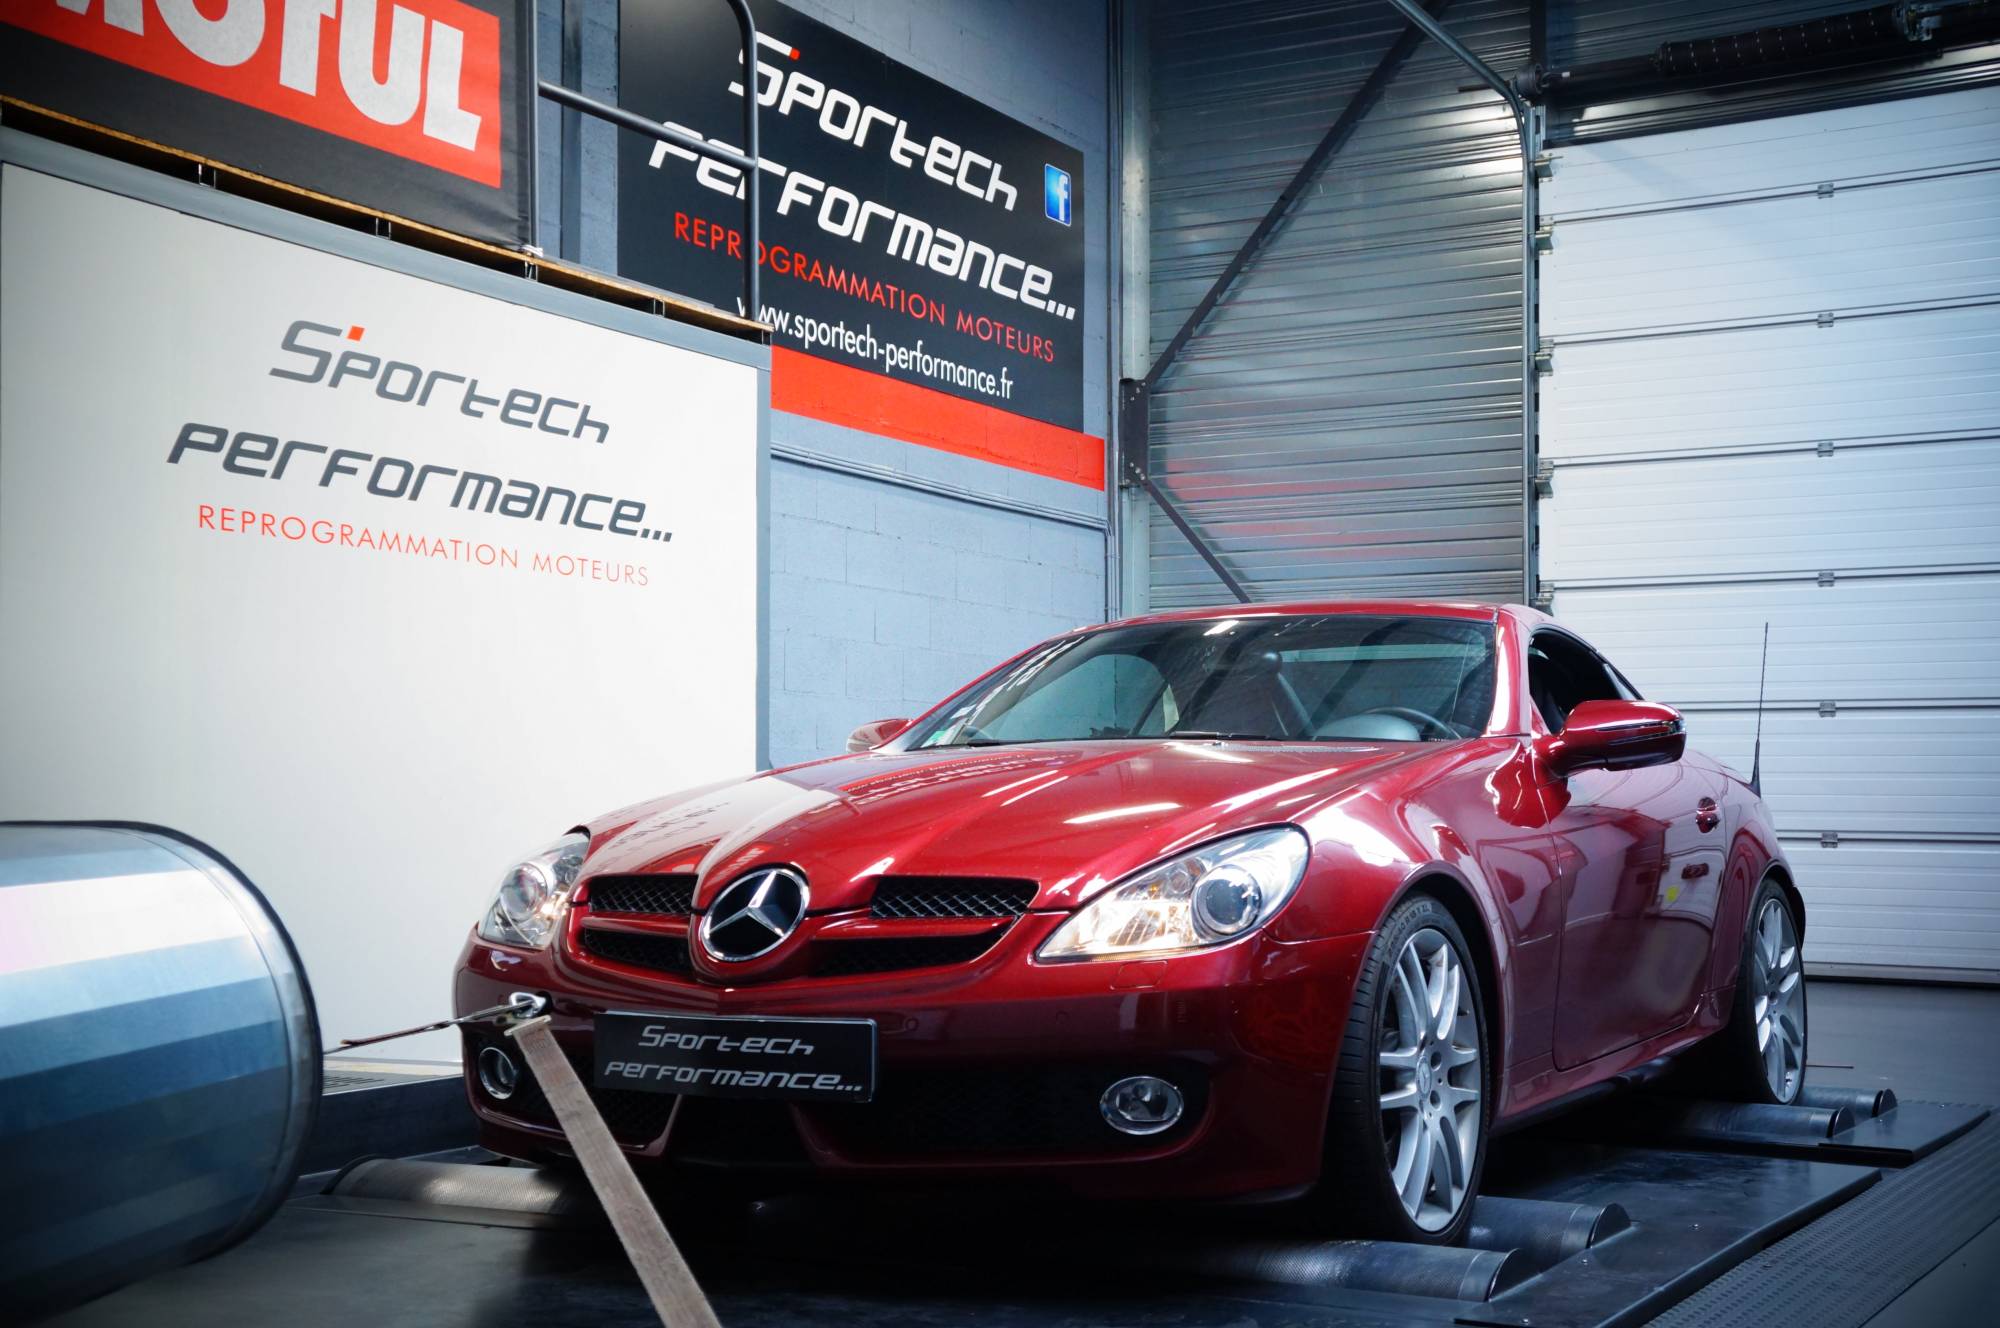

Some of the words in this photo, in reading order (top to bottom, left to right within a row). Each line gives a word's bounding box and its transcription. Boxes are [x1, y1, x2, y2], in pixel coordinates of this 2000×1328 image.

[956, 312, 1054, 362] MOTEURS
[199, 504, 518, 569] REPROGRAMMATION
[532, 552, 649, 586] MOTEURS
